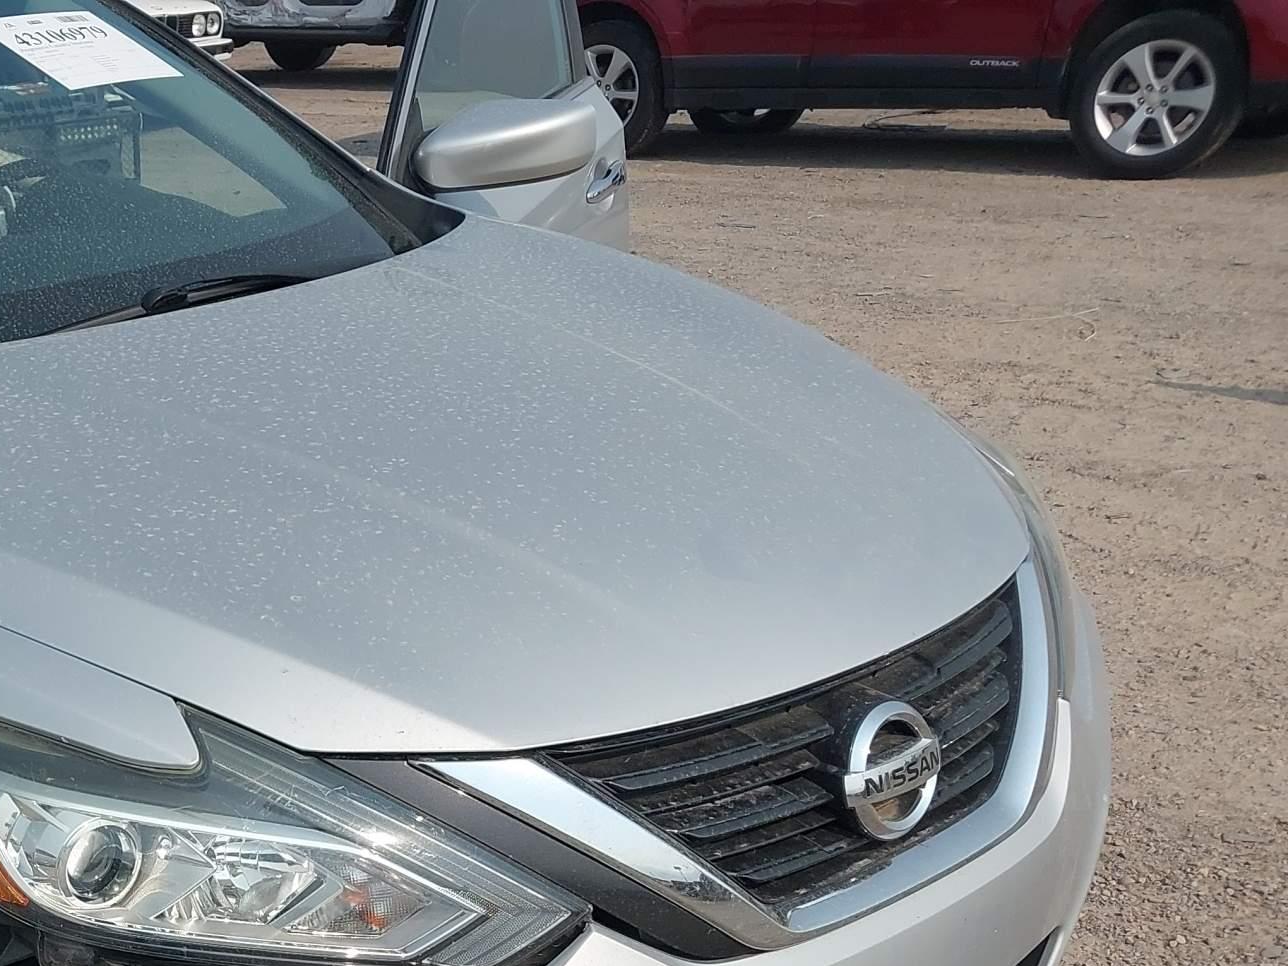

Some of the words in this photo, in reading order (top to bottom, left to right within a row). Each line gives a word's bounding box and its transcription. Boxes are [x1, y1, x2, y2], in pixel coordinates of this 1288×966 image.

[14, 25, 108, 46] 43106979
[969, 59, 1020, 68] OUTBACK
[864, 746, 940, 798] NISSAN
